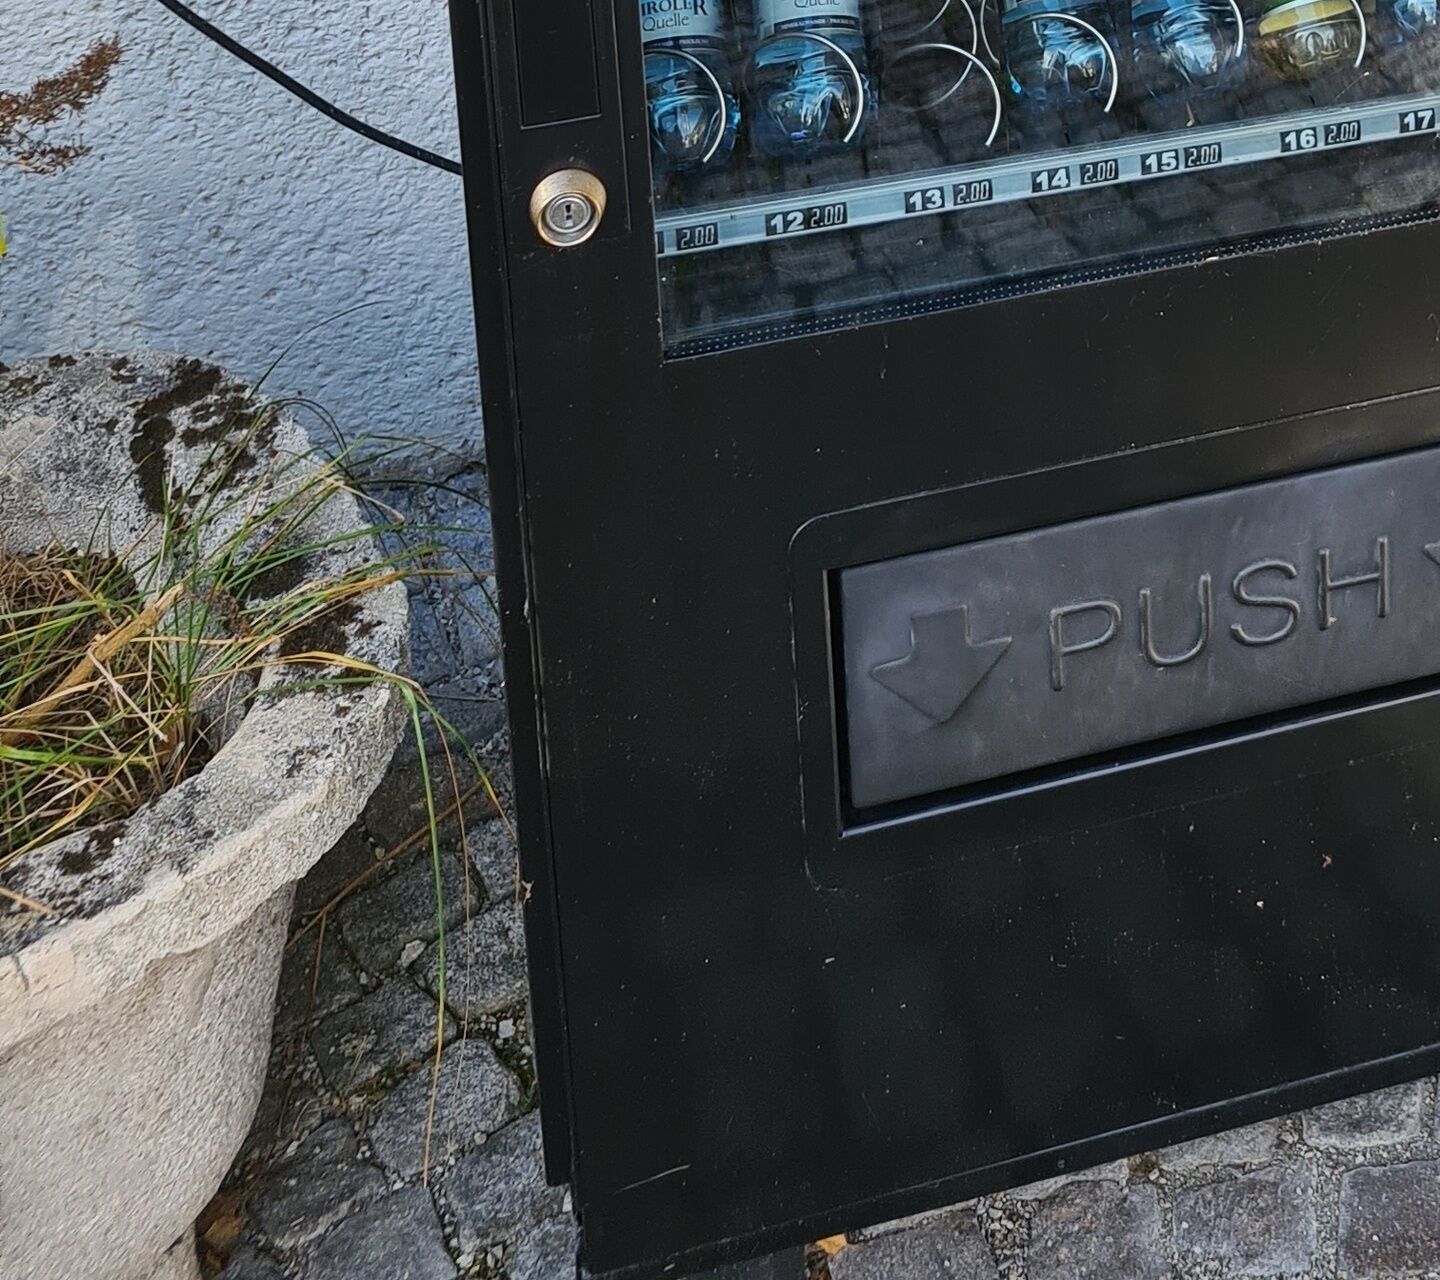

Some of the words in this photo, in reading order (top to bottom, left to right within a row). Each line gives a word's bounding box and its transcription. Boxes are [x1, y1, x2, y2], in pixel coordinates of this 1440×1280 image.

[642, 14, 690, 32] Quelle
[1403, 109, 1434, 130] 17
[1284, 128, 1316, 149] 16
[1328, 122, 1358, 143] 2.00
[1145, 151, 1178, 172] 15
[1188, 144, 1219, 166] 2.00
[1036, 169, 1069, 191] 14
[1083, 162, 1116, 184] 2.00
[909, 188, 942, 210] 13
[956, 181, 990, 203] 2.00
[770, 211, 804, 234] 12
[809, 204, 844, 227] 2.00
[680, 225, 715, 248] 2.00
[1049, 536, 1390, 693] PUSH
